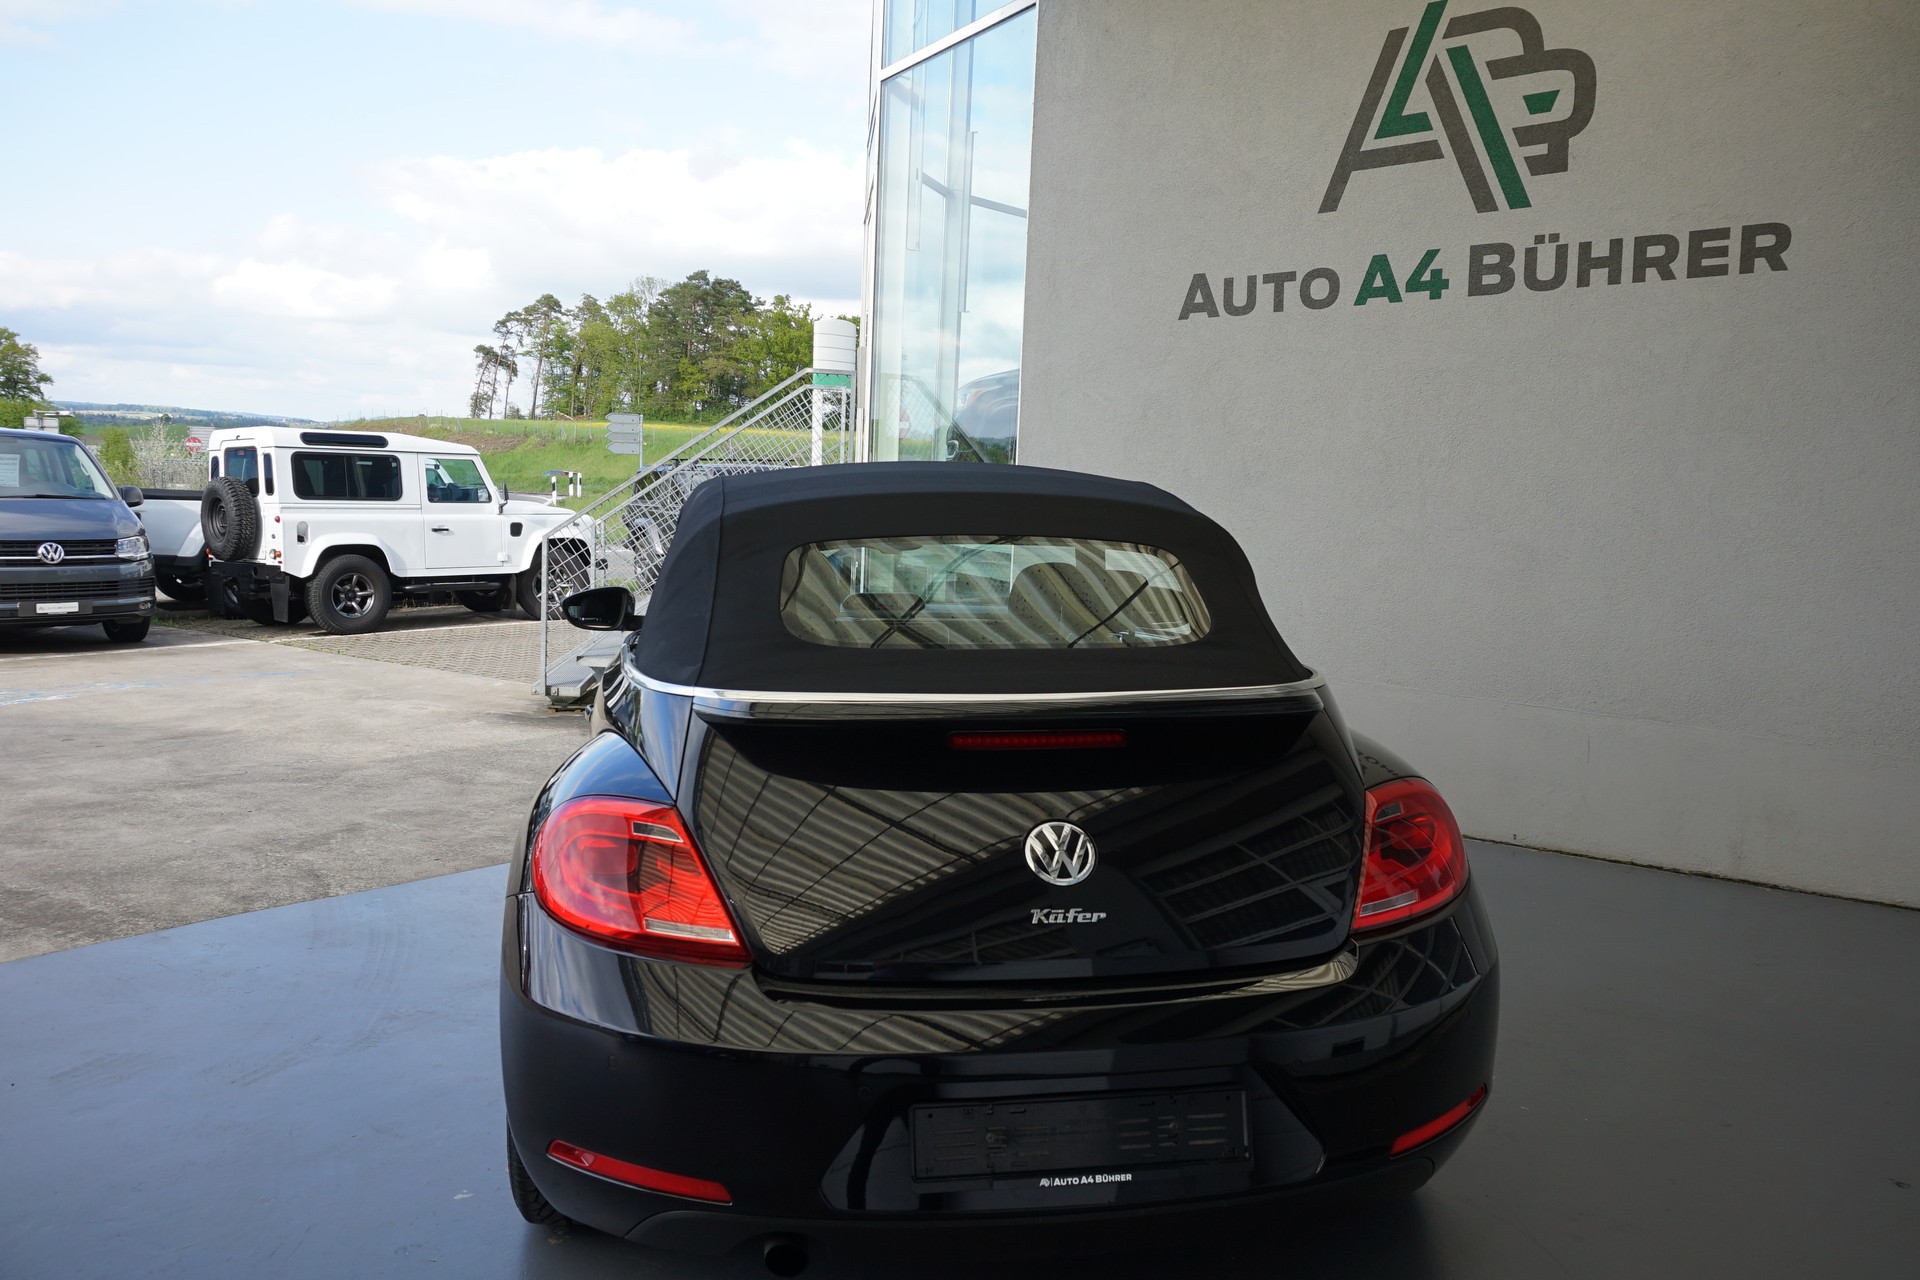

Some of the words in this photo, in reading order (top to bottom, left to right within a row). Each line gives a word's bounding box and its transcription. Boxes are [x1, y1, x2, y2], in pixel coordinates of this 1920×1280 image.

[1178, 268, 1340, 320] AUTO
[1354, 249, 1449, 306] A4
[1468, 222, 1792, 297] BÜHRER
[1030, 907, 1107, 924] Käfer
[1053, 1177, 1079, 1186] AUTO
[1080, 1175, 1094, 1184] A4
[1095, 1173, 1132, 1183] BÜHRER
